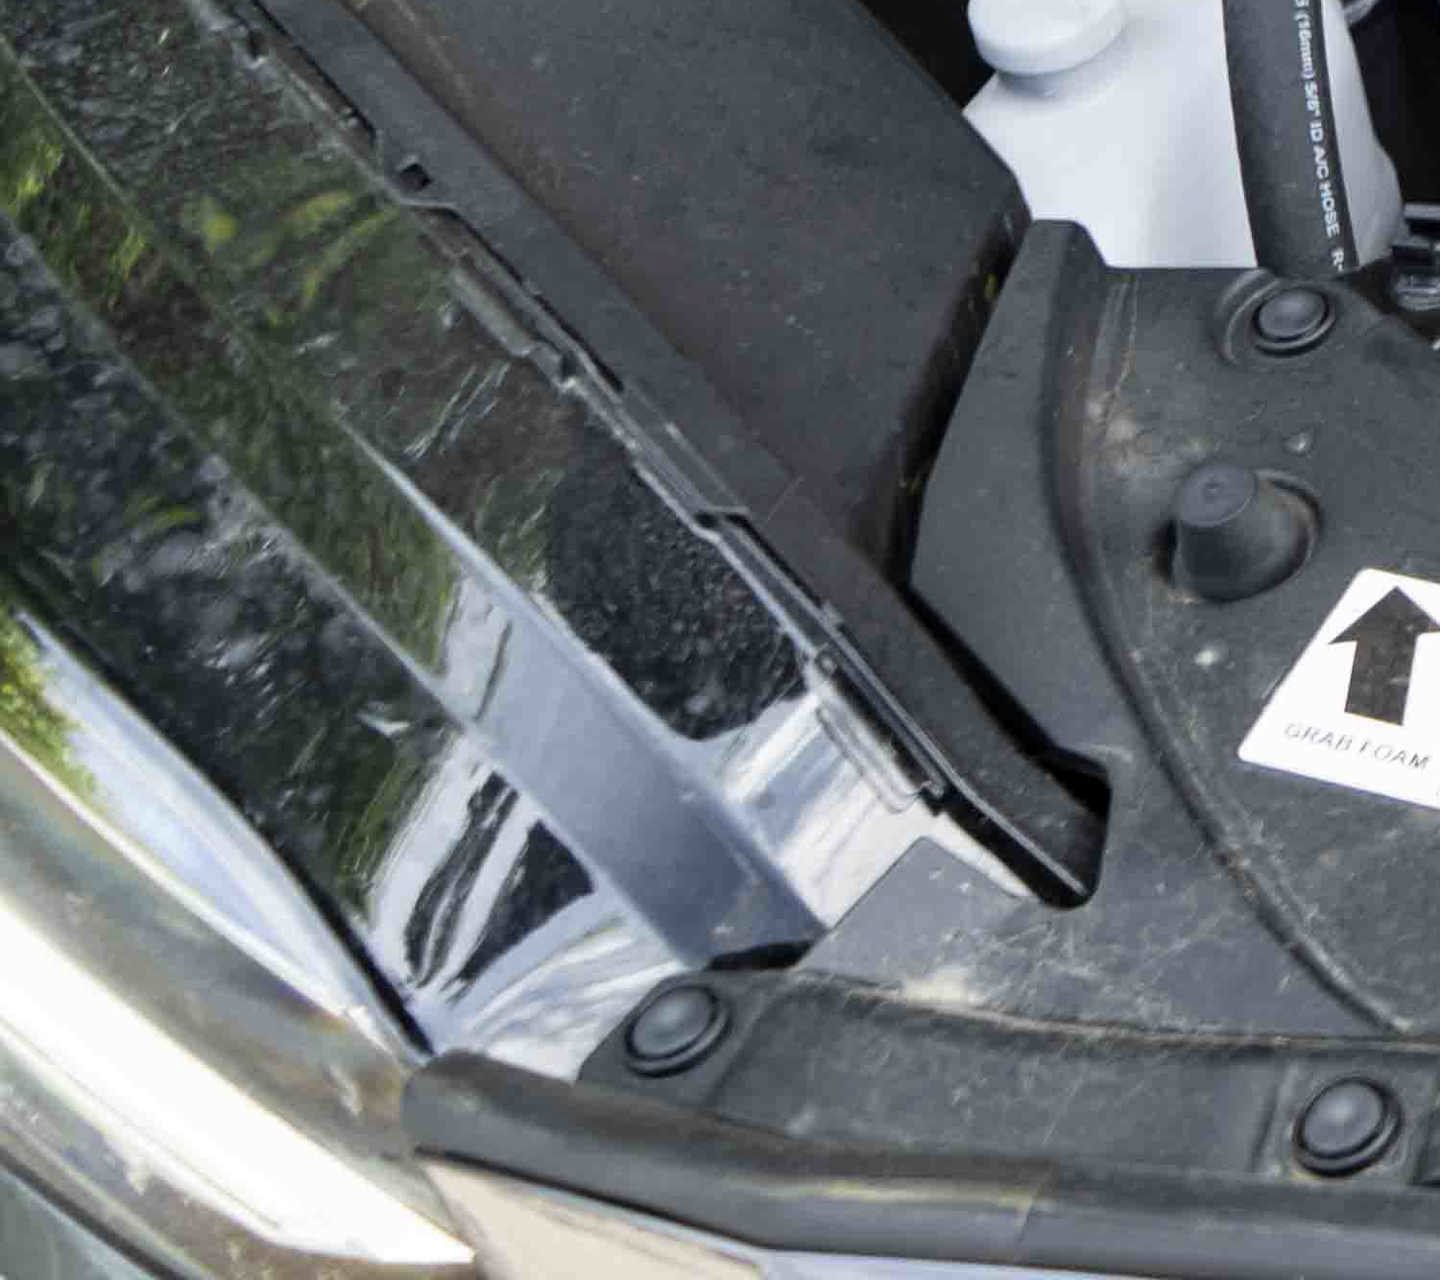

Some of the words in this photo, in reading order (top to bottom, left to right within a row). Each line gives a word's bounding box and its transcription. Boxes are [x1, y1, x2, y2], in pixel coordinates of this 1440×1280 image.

[1309, 121, 1324, 142] ID
[1313, 145, 1329, 179] A/C
[1319, 180, 1340, 238] HOSE
[1284, 722, 1353, 751] GRAB
[1359, 740, 1431, 770] FOAM
